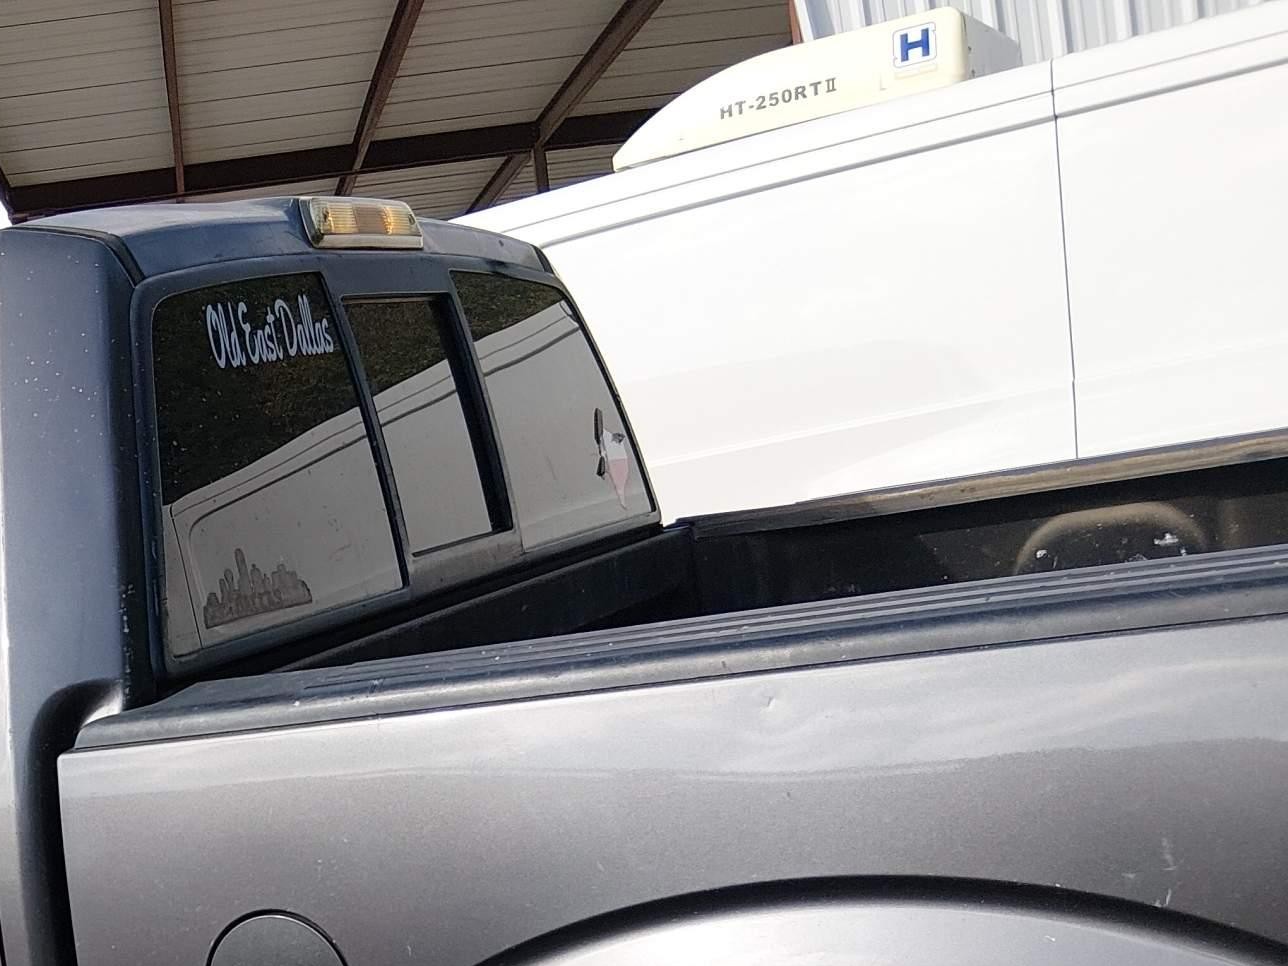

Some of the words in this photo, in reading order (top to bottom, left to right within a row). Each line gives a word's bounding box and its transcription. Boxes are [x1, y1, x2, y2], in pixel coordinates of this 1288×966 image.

[206, 301, 247, 369] Old
[237, 301, 285, 365] East
[274, 293, 334, 357] Dallas
